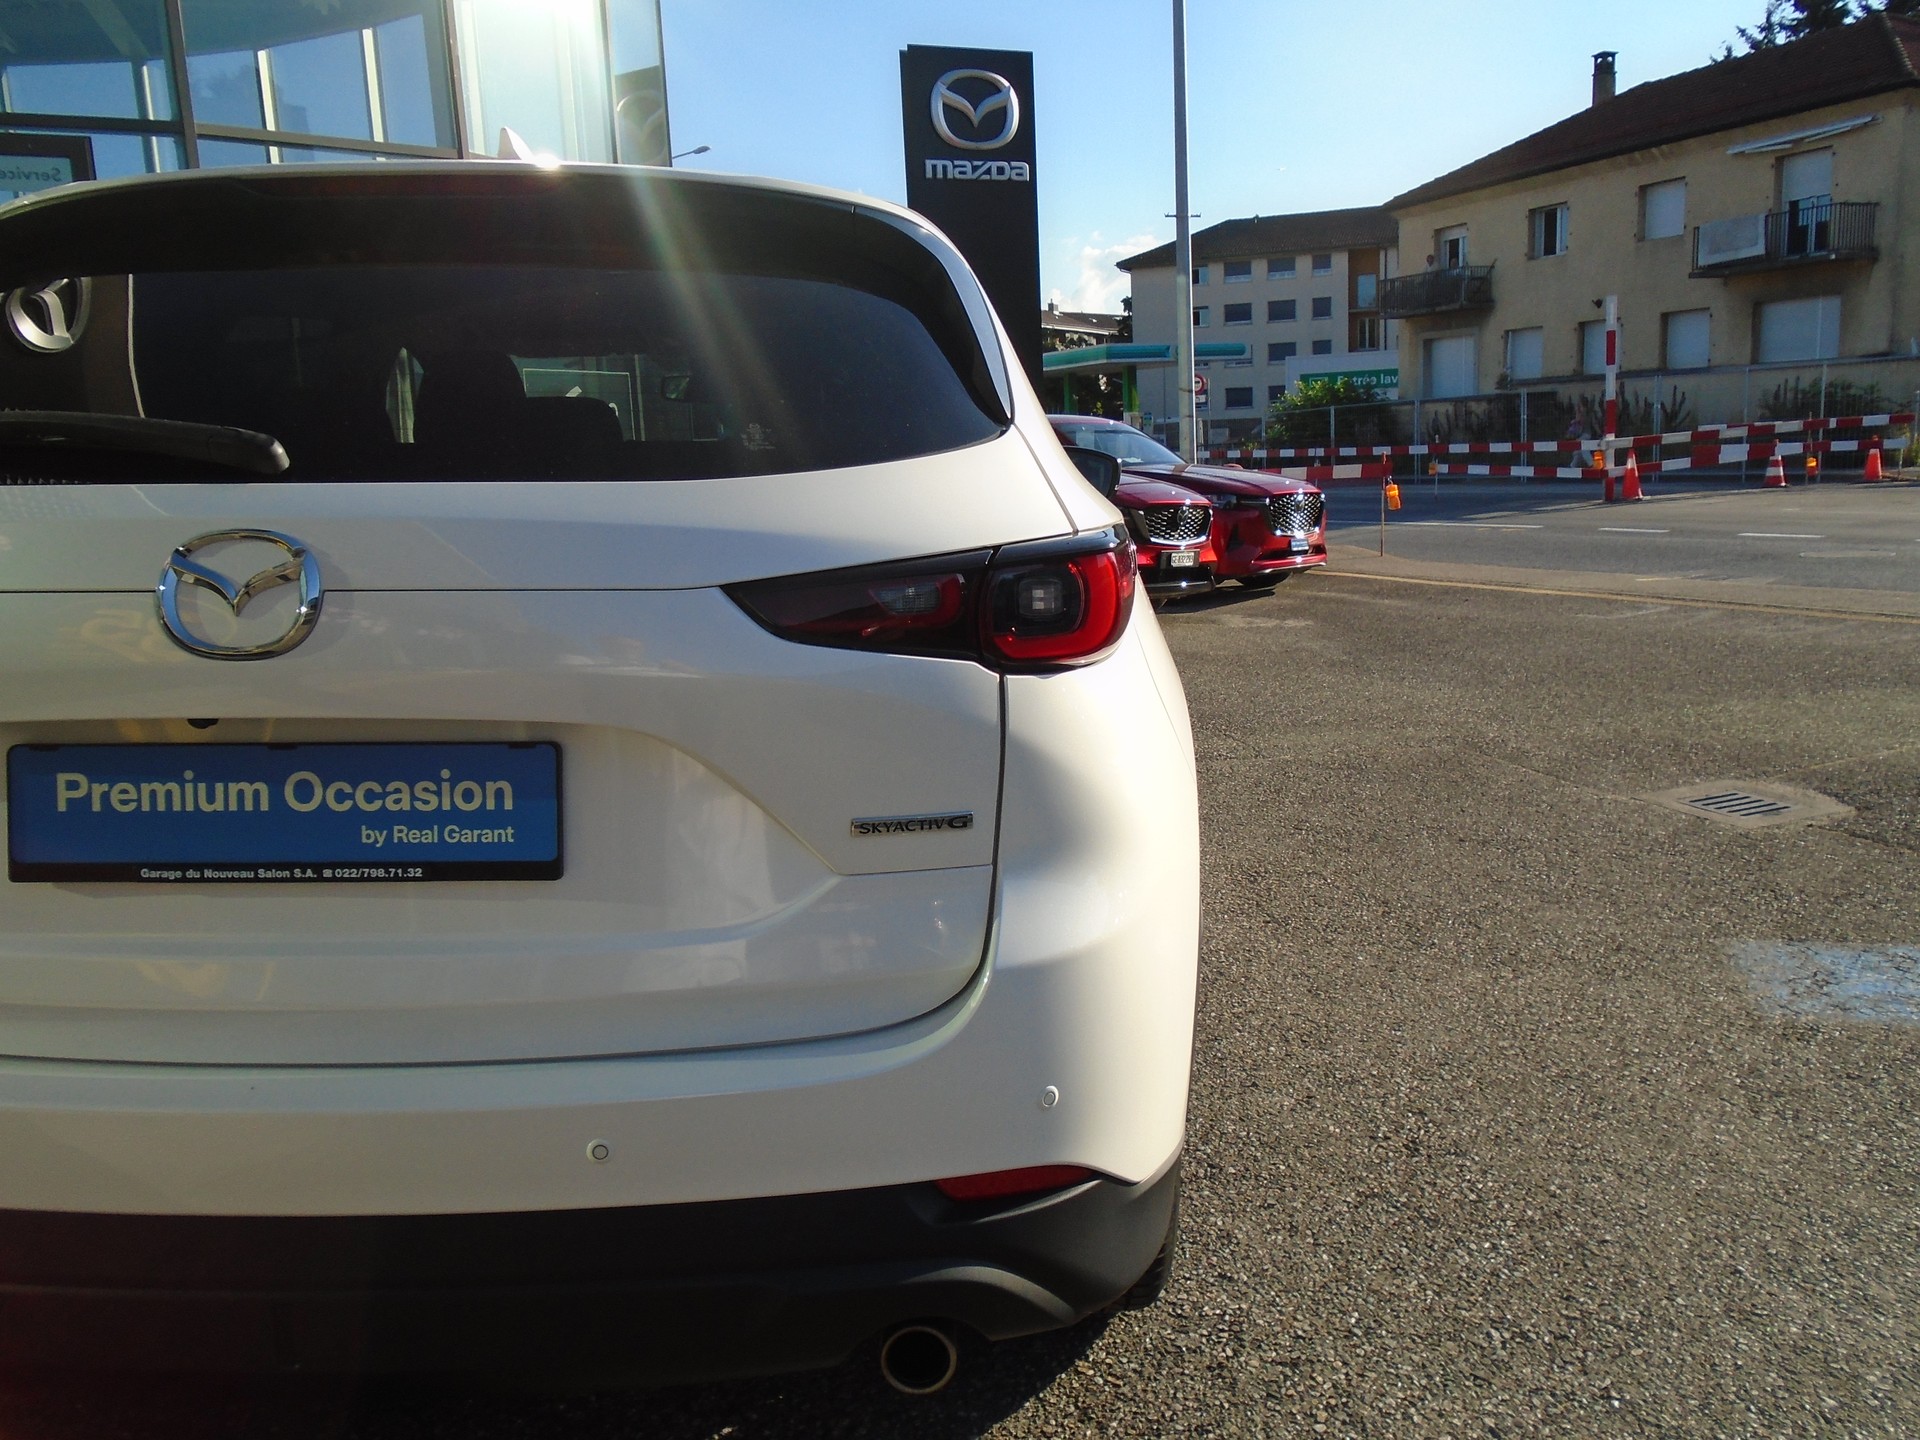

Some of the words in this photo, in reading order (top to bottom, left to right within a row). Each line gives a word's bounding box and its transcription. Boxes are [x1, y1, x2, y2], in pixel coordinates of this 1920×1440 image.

[925, 159, 1030, 181] mazda
[56, 770, 269, 812] Premium
[284, 768, 513, 812] Occasion
[361, 825, 387, 847] by
[393, 825, 438, 843] Real
[443, 825, 514, 843] Garant
[140, 869, 182, 879] Garage
[185, 869, 200, 878] du
[204, 869, 254, 878] Nouveau
[257, 869, 290, 878] Salon
[293, 869, 317, 878] S.A.
